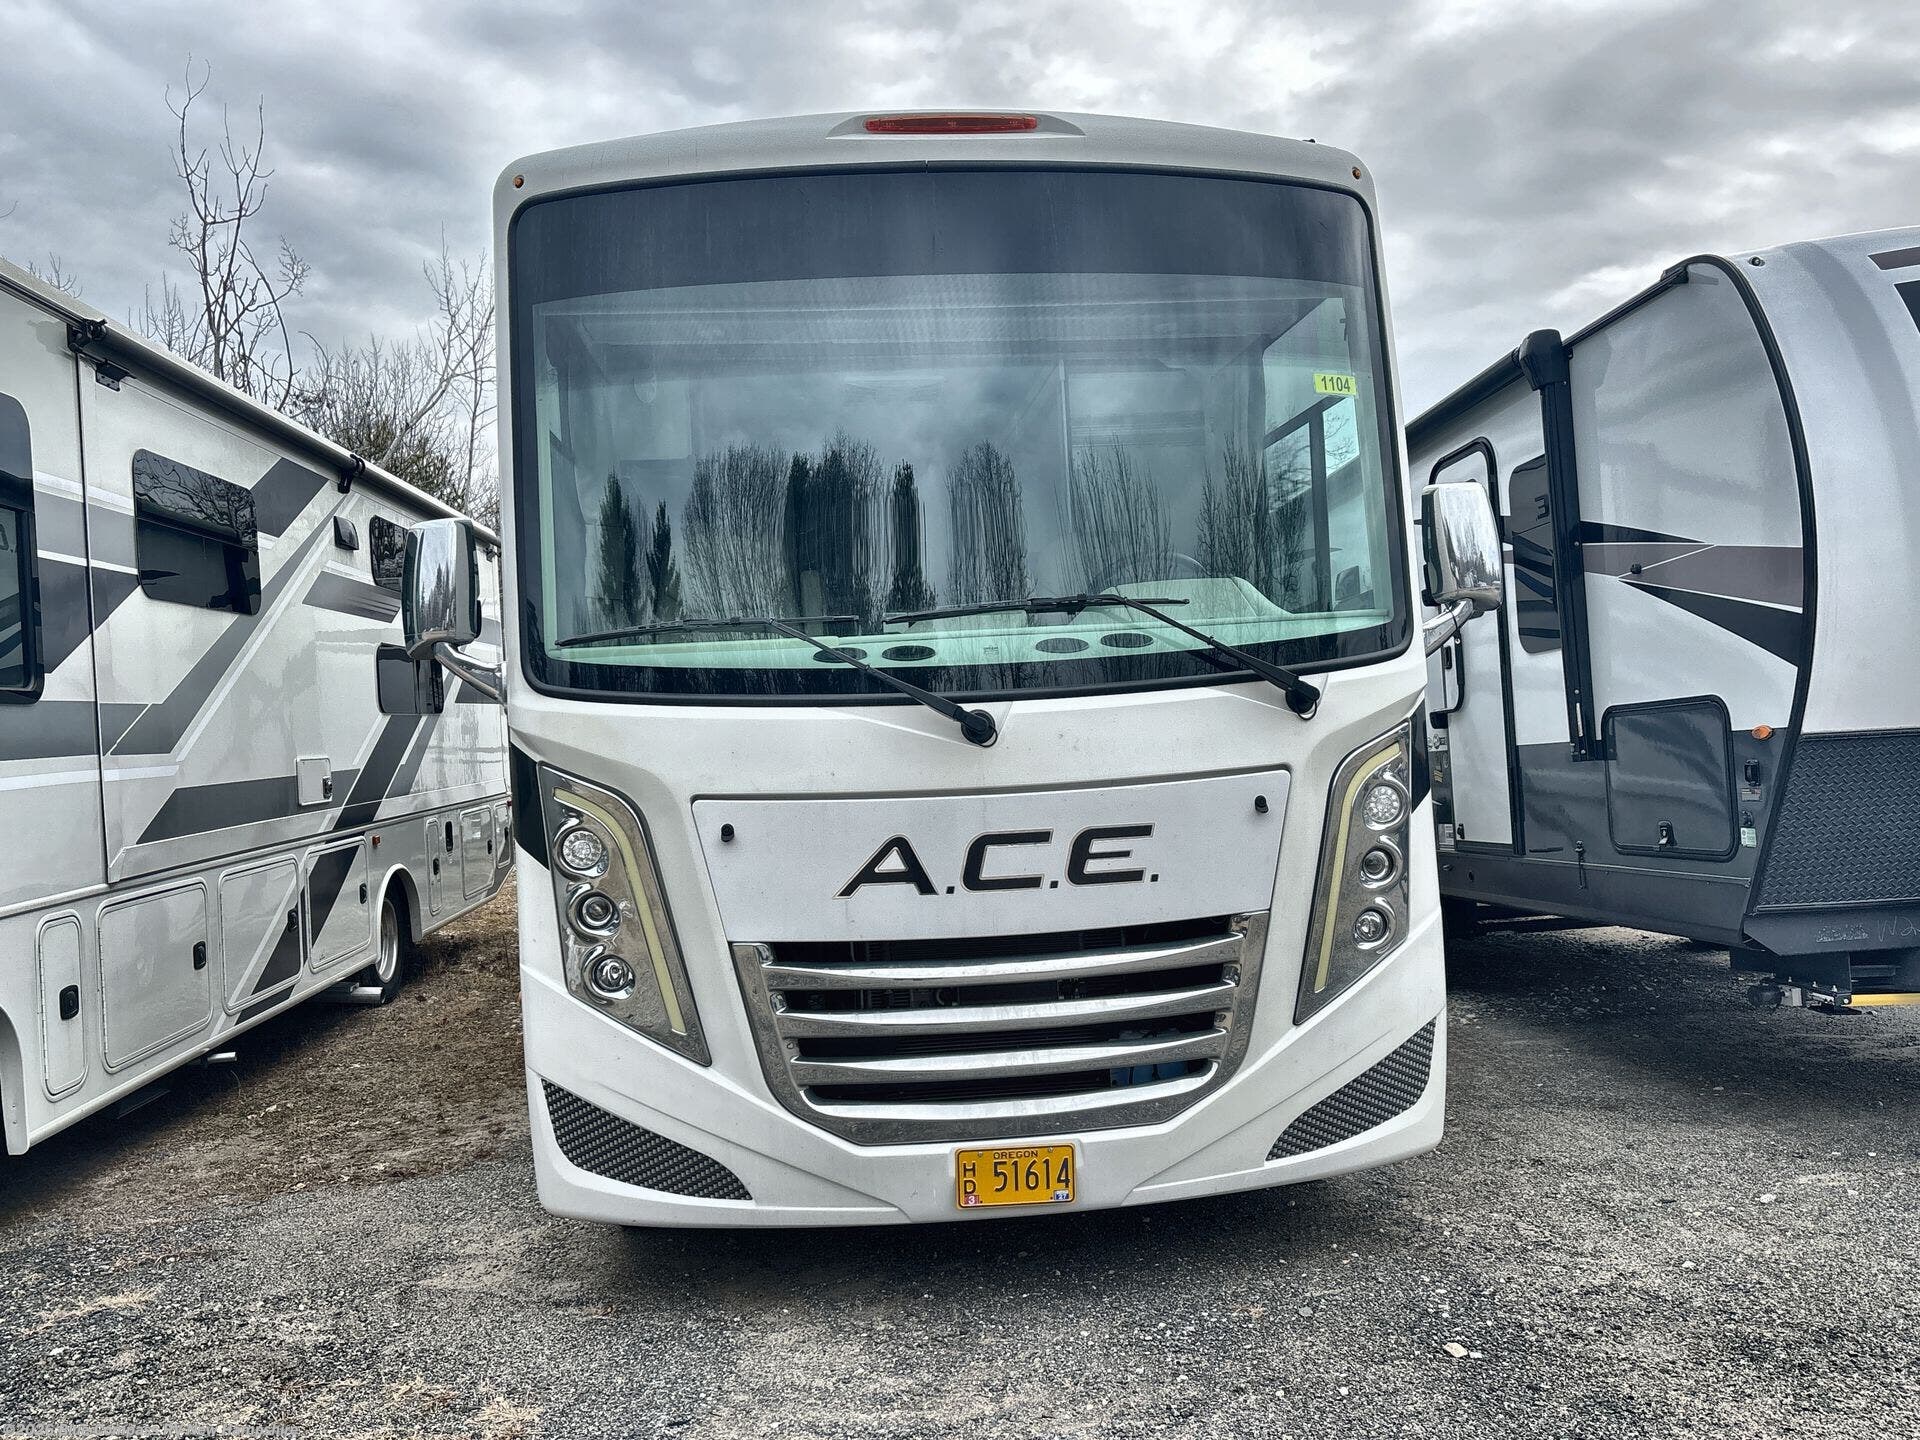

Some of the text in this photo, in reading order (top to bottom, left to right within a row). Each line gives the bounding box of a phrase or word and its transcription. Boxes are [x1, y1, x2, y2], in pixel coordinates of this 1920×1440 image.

[1321, 375, 1351, 392] 1104
[832, 823, 1159, 899] A.C.E.
[993, 1150, 1038, 1159] OREGON
[993, 1157, 1071, 1192] 51614
[968, 1195, 976, 1204] 3
